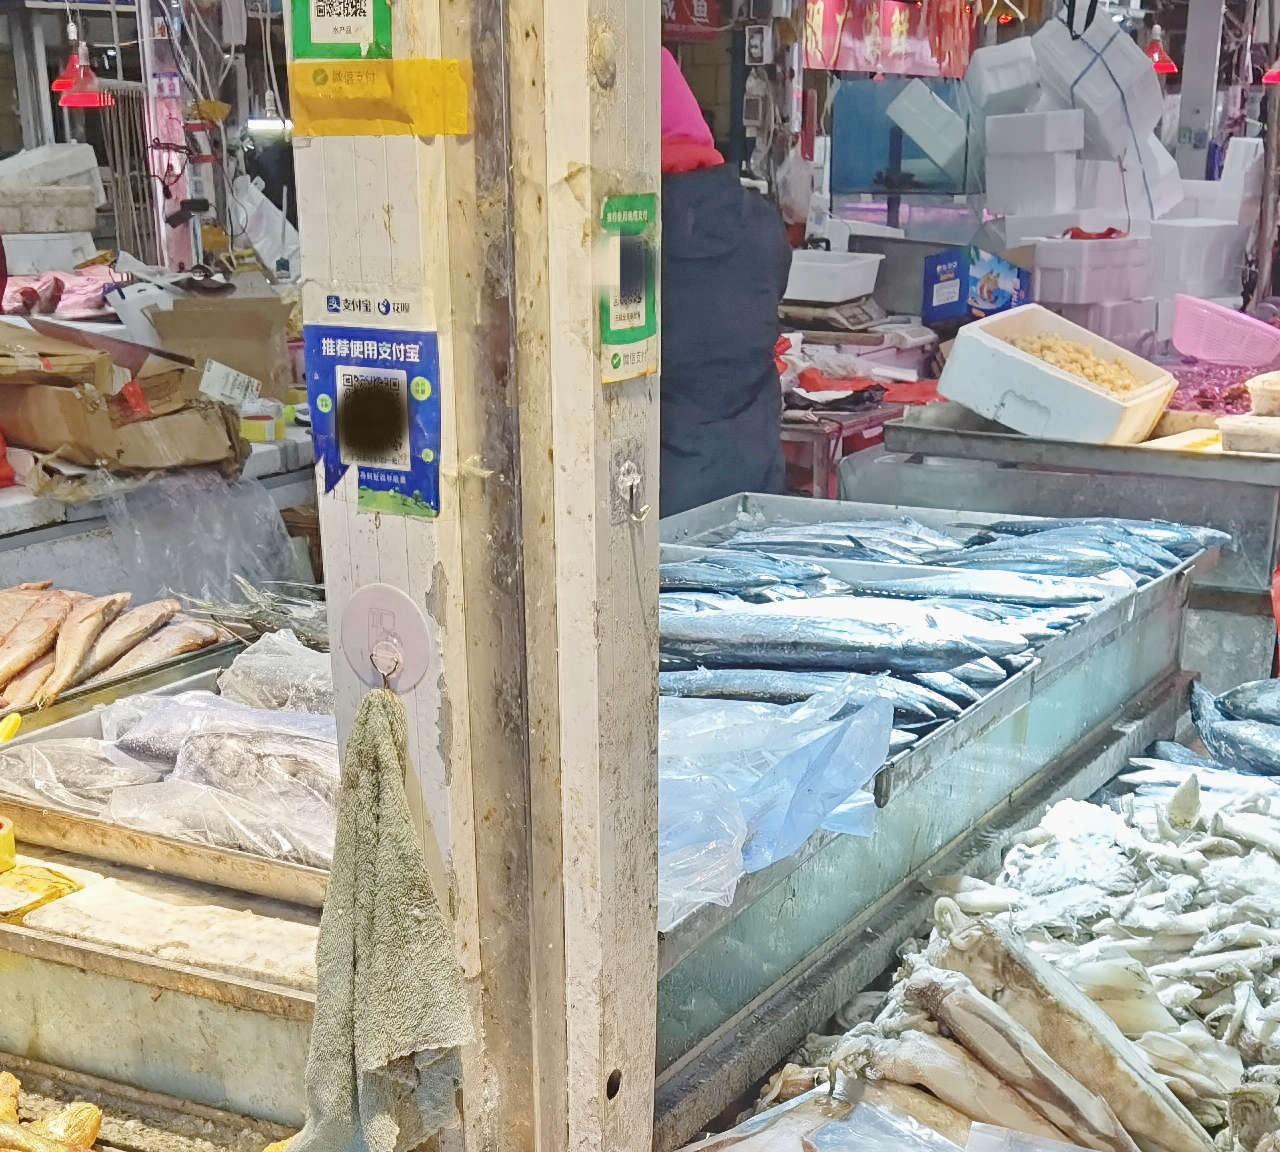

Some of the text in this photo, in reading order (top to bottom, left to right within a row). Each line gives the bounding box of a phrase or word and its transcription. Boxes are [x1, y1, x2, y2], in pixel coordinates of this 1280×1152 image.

[322, 337, 420, 363] 推荐使用支付宝
